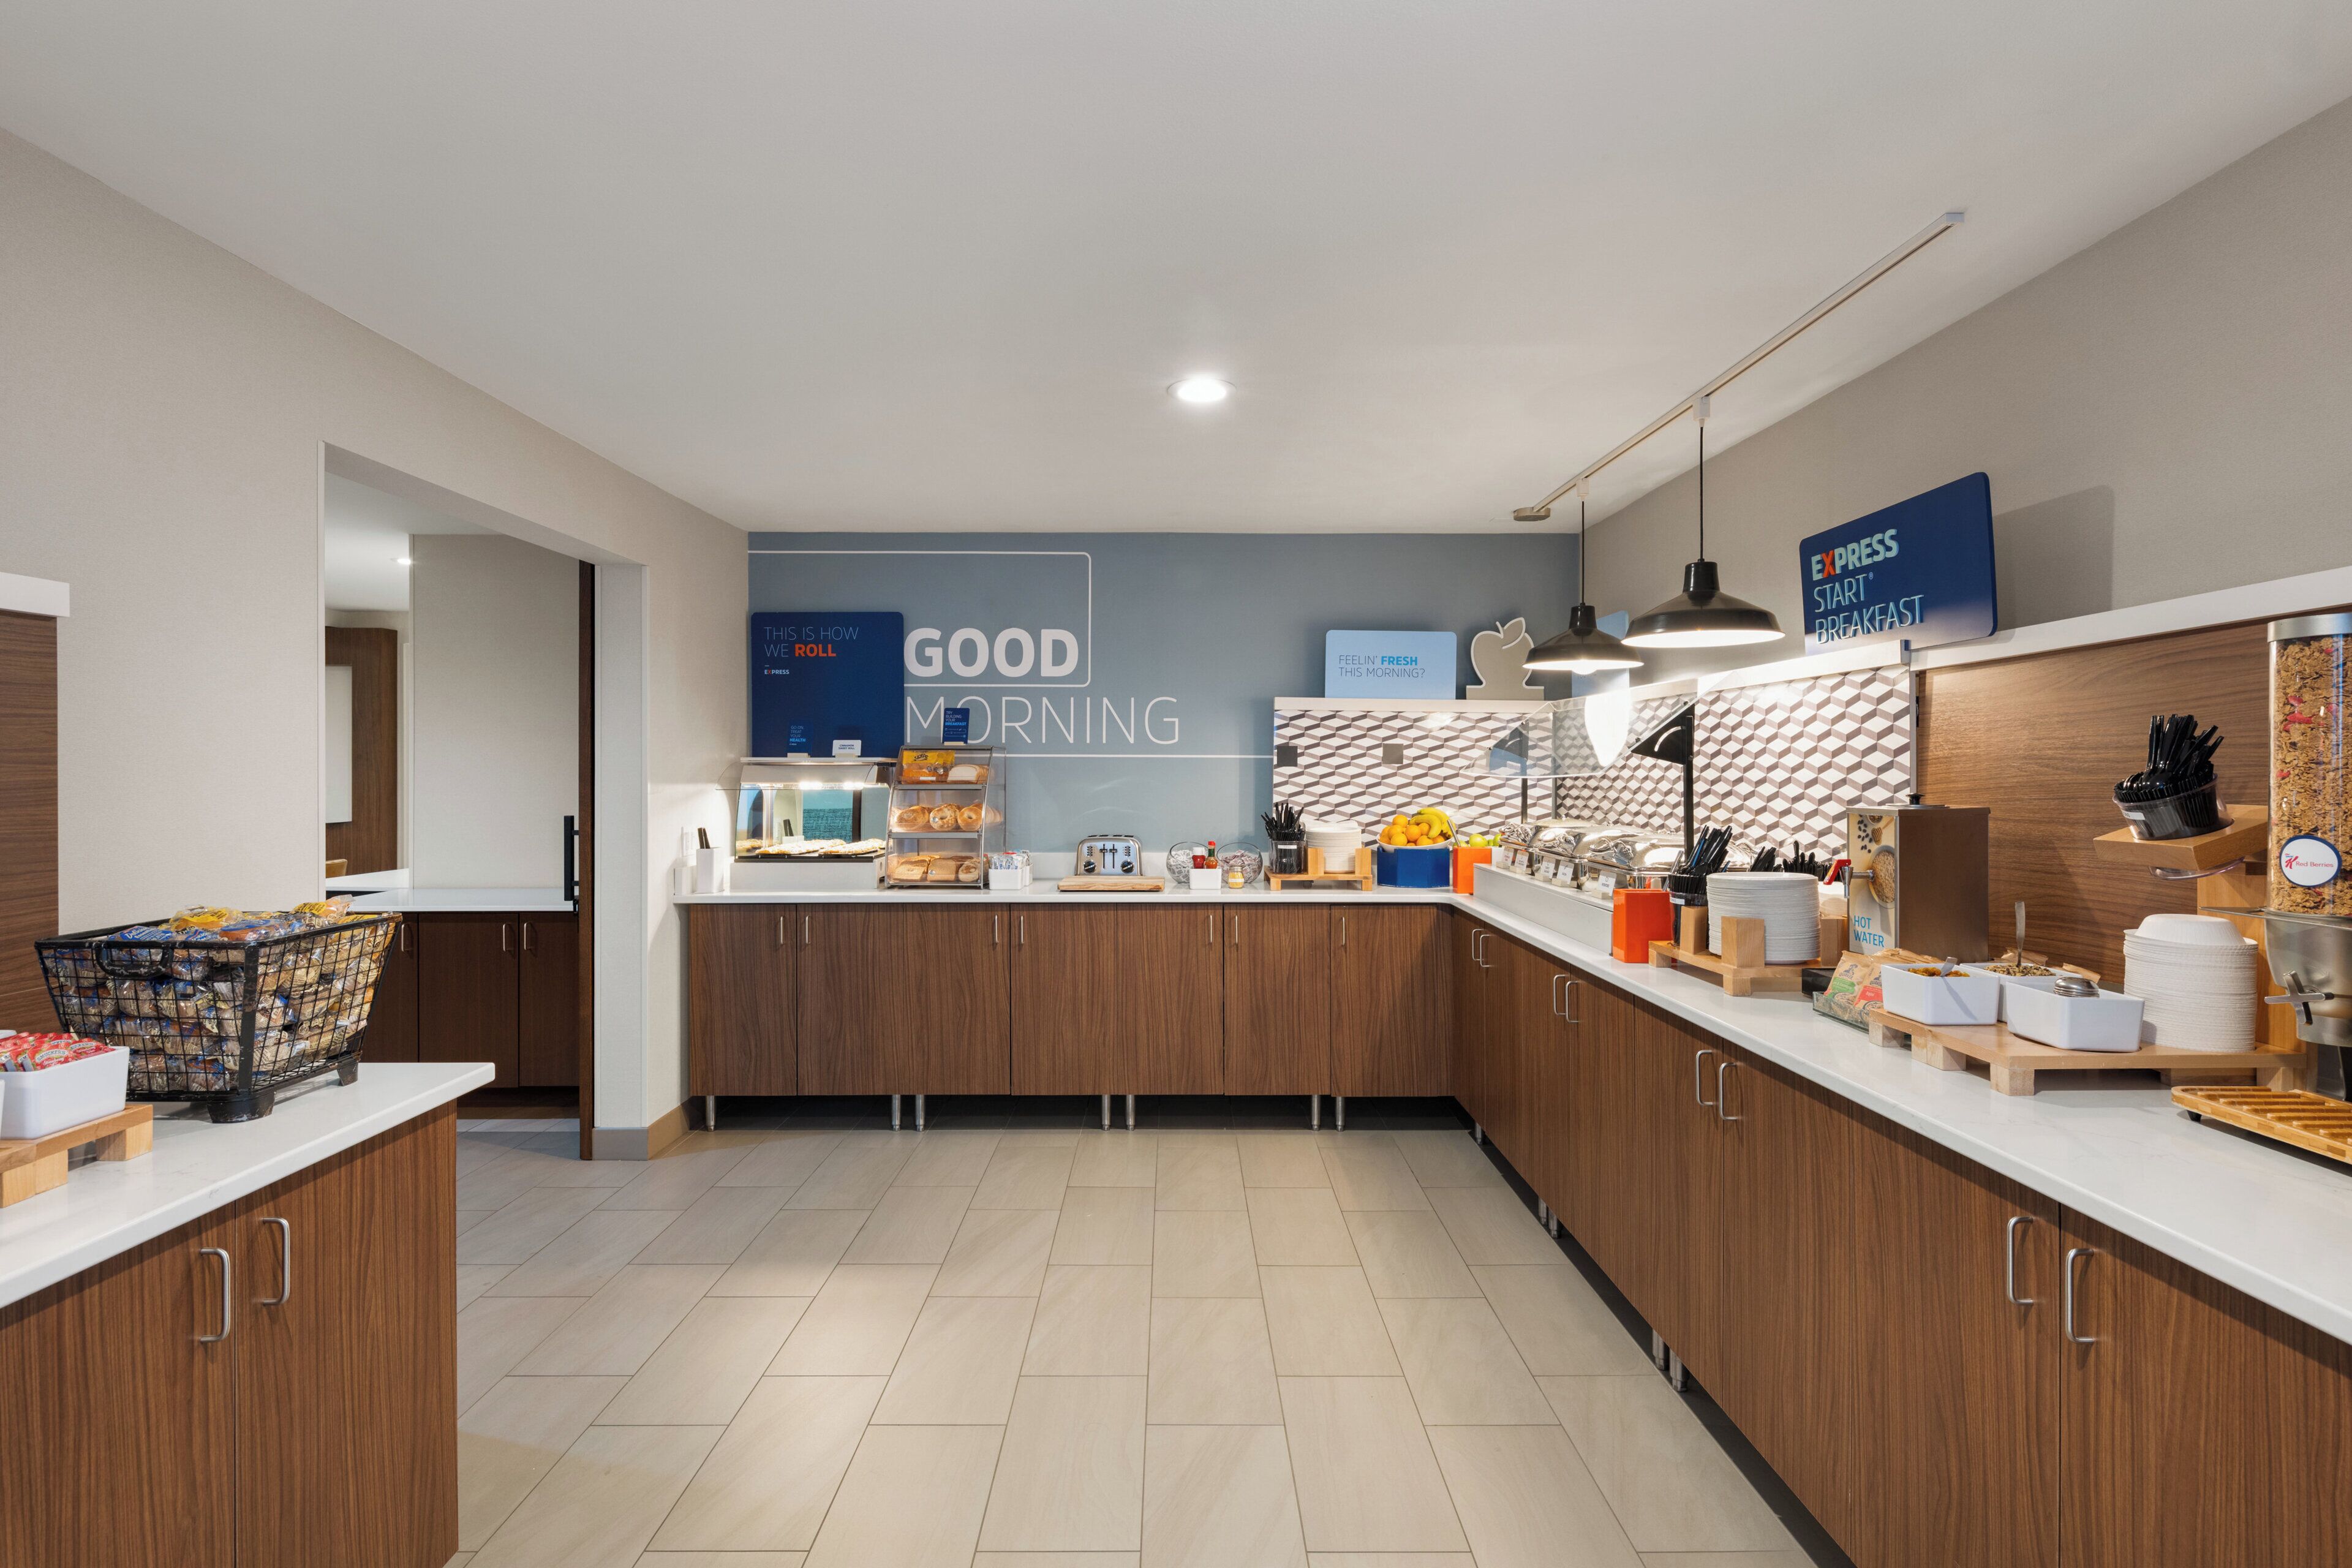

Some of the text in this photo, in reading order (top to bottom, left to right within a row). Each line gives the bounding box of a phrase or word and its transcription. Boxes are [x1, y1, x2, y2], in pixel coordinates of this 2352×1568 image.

[1811, 529, 1899, 581] EXPRESS
[1815, 595, 1924, 644] BREAKFAST
[764, 627, 858, 640] THIS IS HOW
[764, 644, 837, 657] WE ROLL
[903, 627, 1079, 677] GOOD
[1339, 655, 1418, 666] FEELIN' FRESH
[1339, 667, 1425, 678] THIS MORNING?
[906, 696, 1179, 744] MORNING
[1854, 915, 1872, 929] HOT
[1853, 929, 1884, 948] WATER
